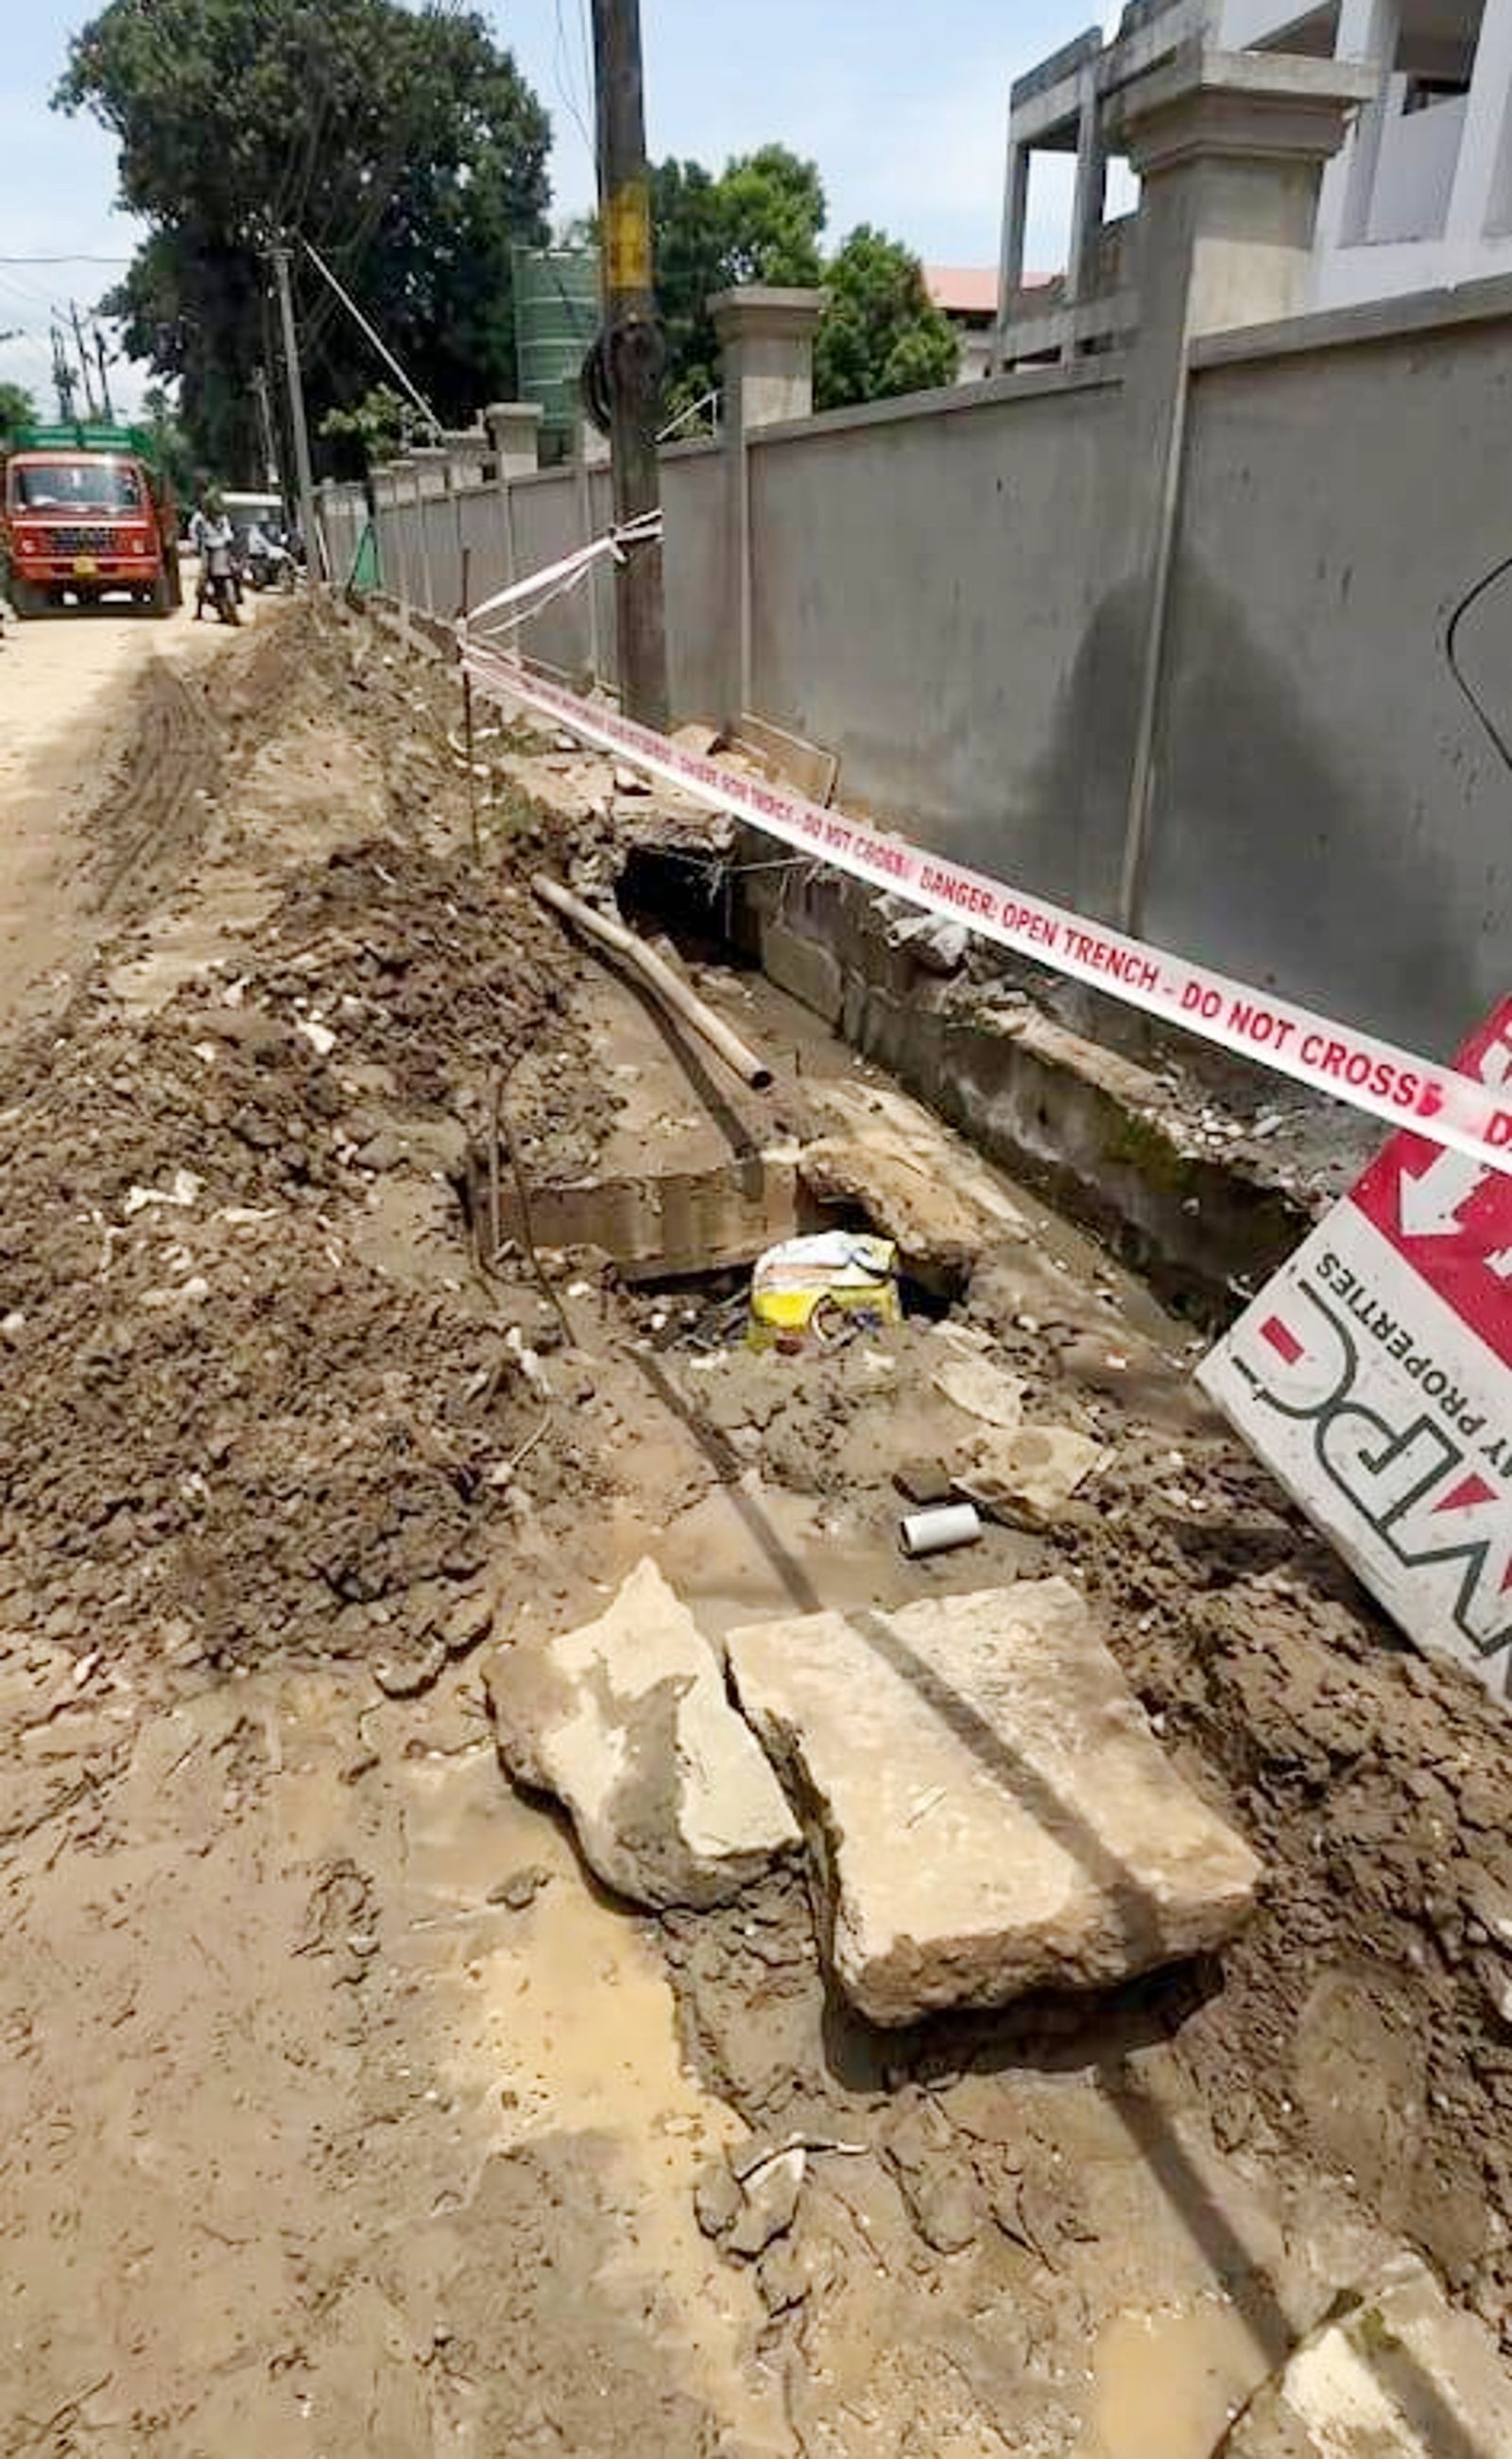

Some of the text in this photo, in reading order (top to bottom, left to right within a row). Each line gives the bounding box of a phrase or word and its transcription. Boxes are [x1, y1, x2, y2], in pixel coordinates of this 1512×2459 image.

[919, 866, 997, 919] DANGER:
[1002, 903, 1059, 946] OPEN
[1064, 928, 1161, 990] TRENCH
[1181, 981, 1222, 1018] DO
[1228, 1000, 1296, 1050] NOT
[1484, 1110, 1512, 1152] D
[1315, 1252, 1487, 1436] PROPERTIES
